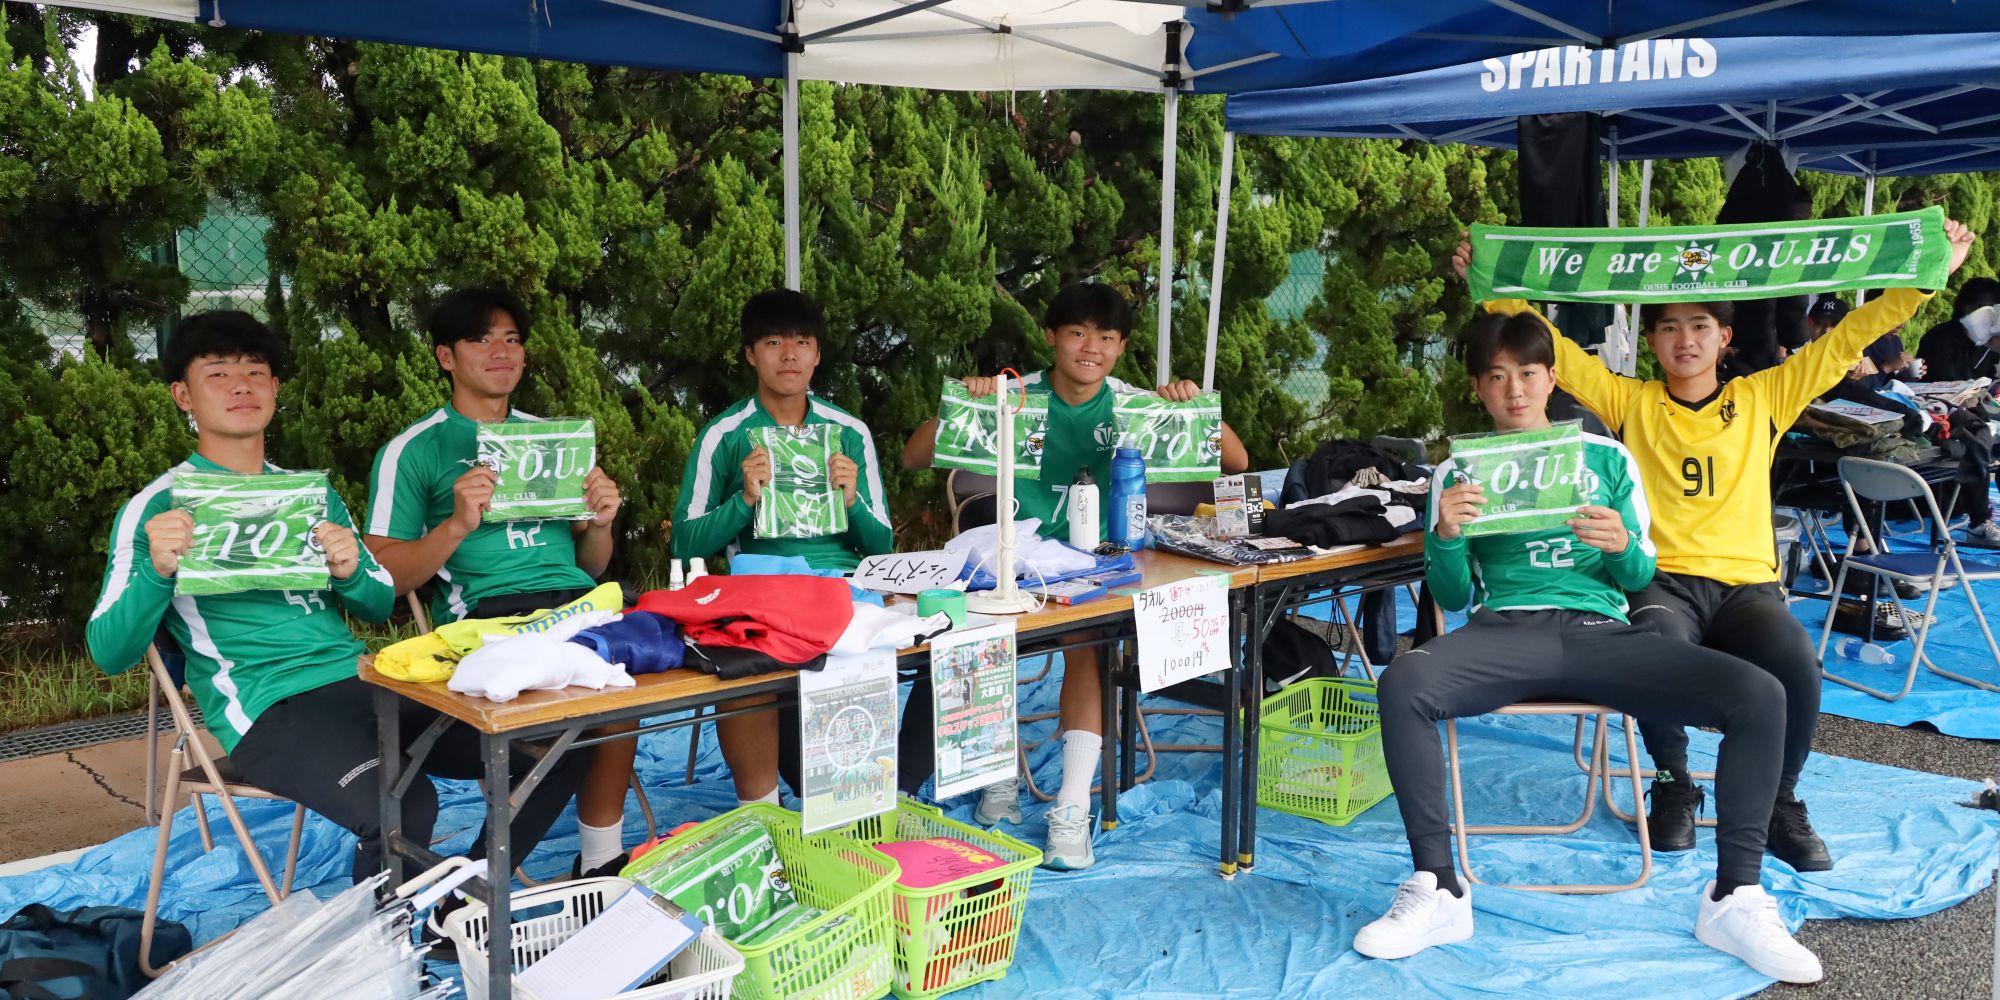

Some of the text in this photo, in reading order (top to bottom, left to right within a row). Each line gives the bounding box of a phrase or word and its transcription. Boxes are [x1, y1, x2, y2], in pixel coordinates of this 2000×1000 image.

[1481, 38, 1717, 92] SPARTANS
[1538, 234, 1871, 276] We are O.U.H.S
[1908, 222, 1924, 273] since 1965
[1643, 279, 1748, 291] OUHS FOOTBALL CLUB
[1681, 456, 1714, 496] 91
[513, 491, 537, 501] CLUB
[1491, 503, 1517, 514] CLUB
[1525, 537, 1575, 568] 22
[1139, 590, 1165, 612] タオル
[1160, 603, 1205, 623] 2000円
[516, 600, 594, 635] umbro
[1163, 650, 1203, 677] 1000円
[719, 858, 744, 878] CLUB
